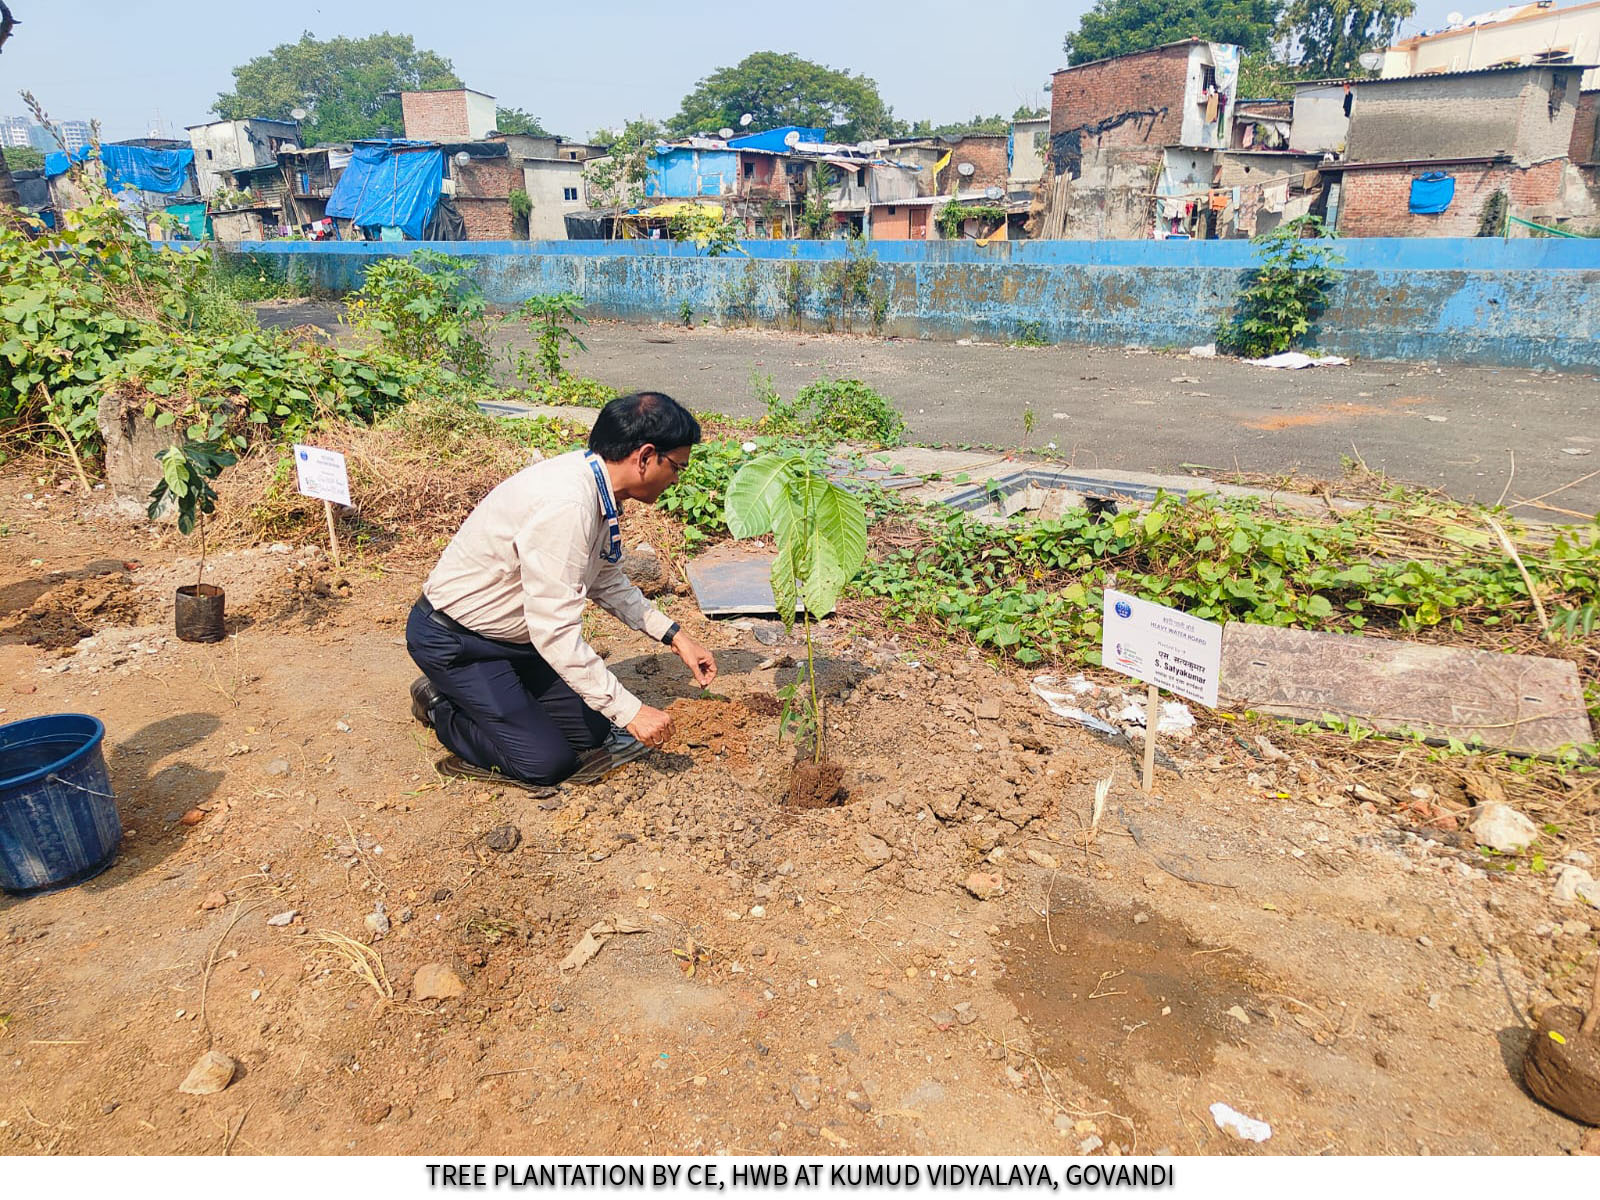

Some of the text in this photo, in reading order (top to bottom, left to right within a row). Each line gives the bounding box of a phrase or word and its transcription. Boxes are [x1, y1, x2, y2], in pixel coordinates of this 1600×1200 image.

[1150, 622, 1207, 646] HEAVY WATER BOARD
[1154, 659, 1162, 668] S.
[1164, 662, 1206, 685] Satyakumar
